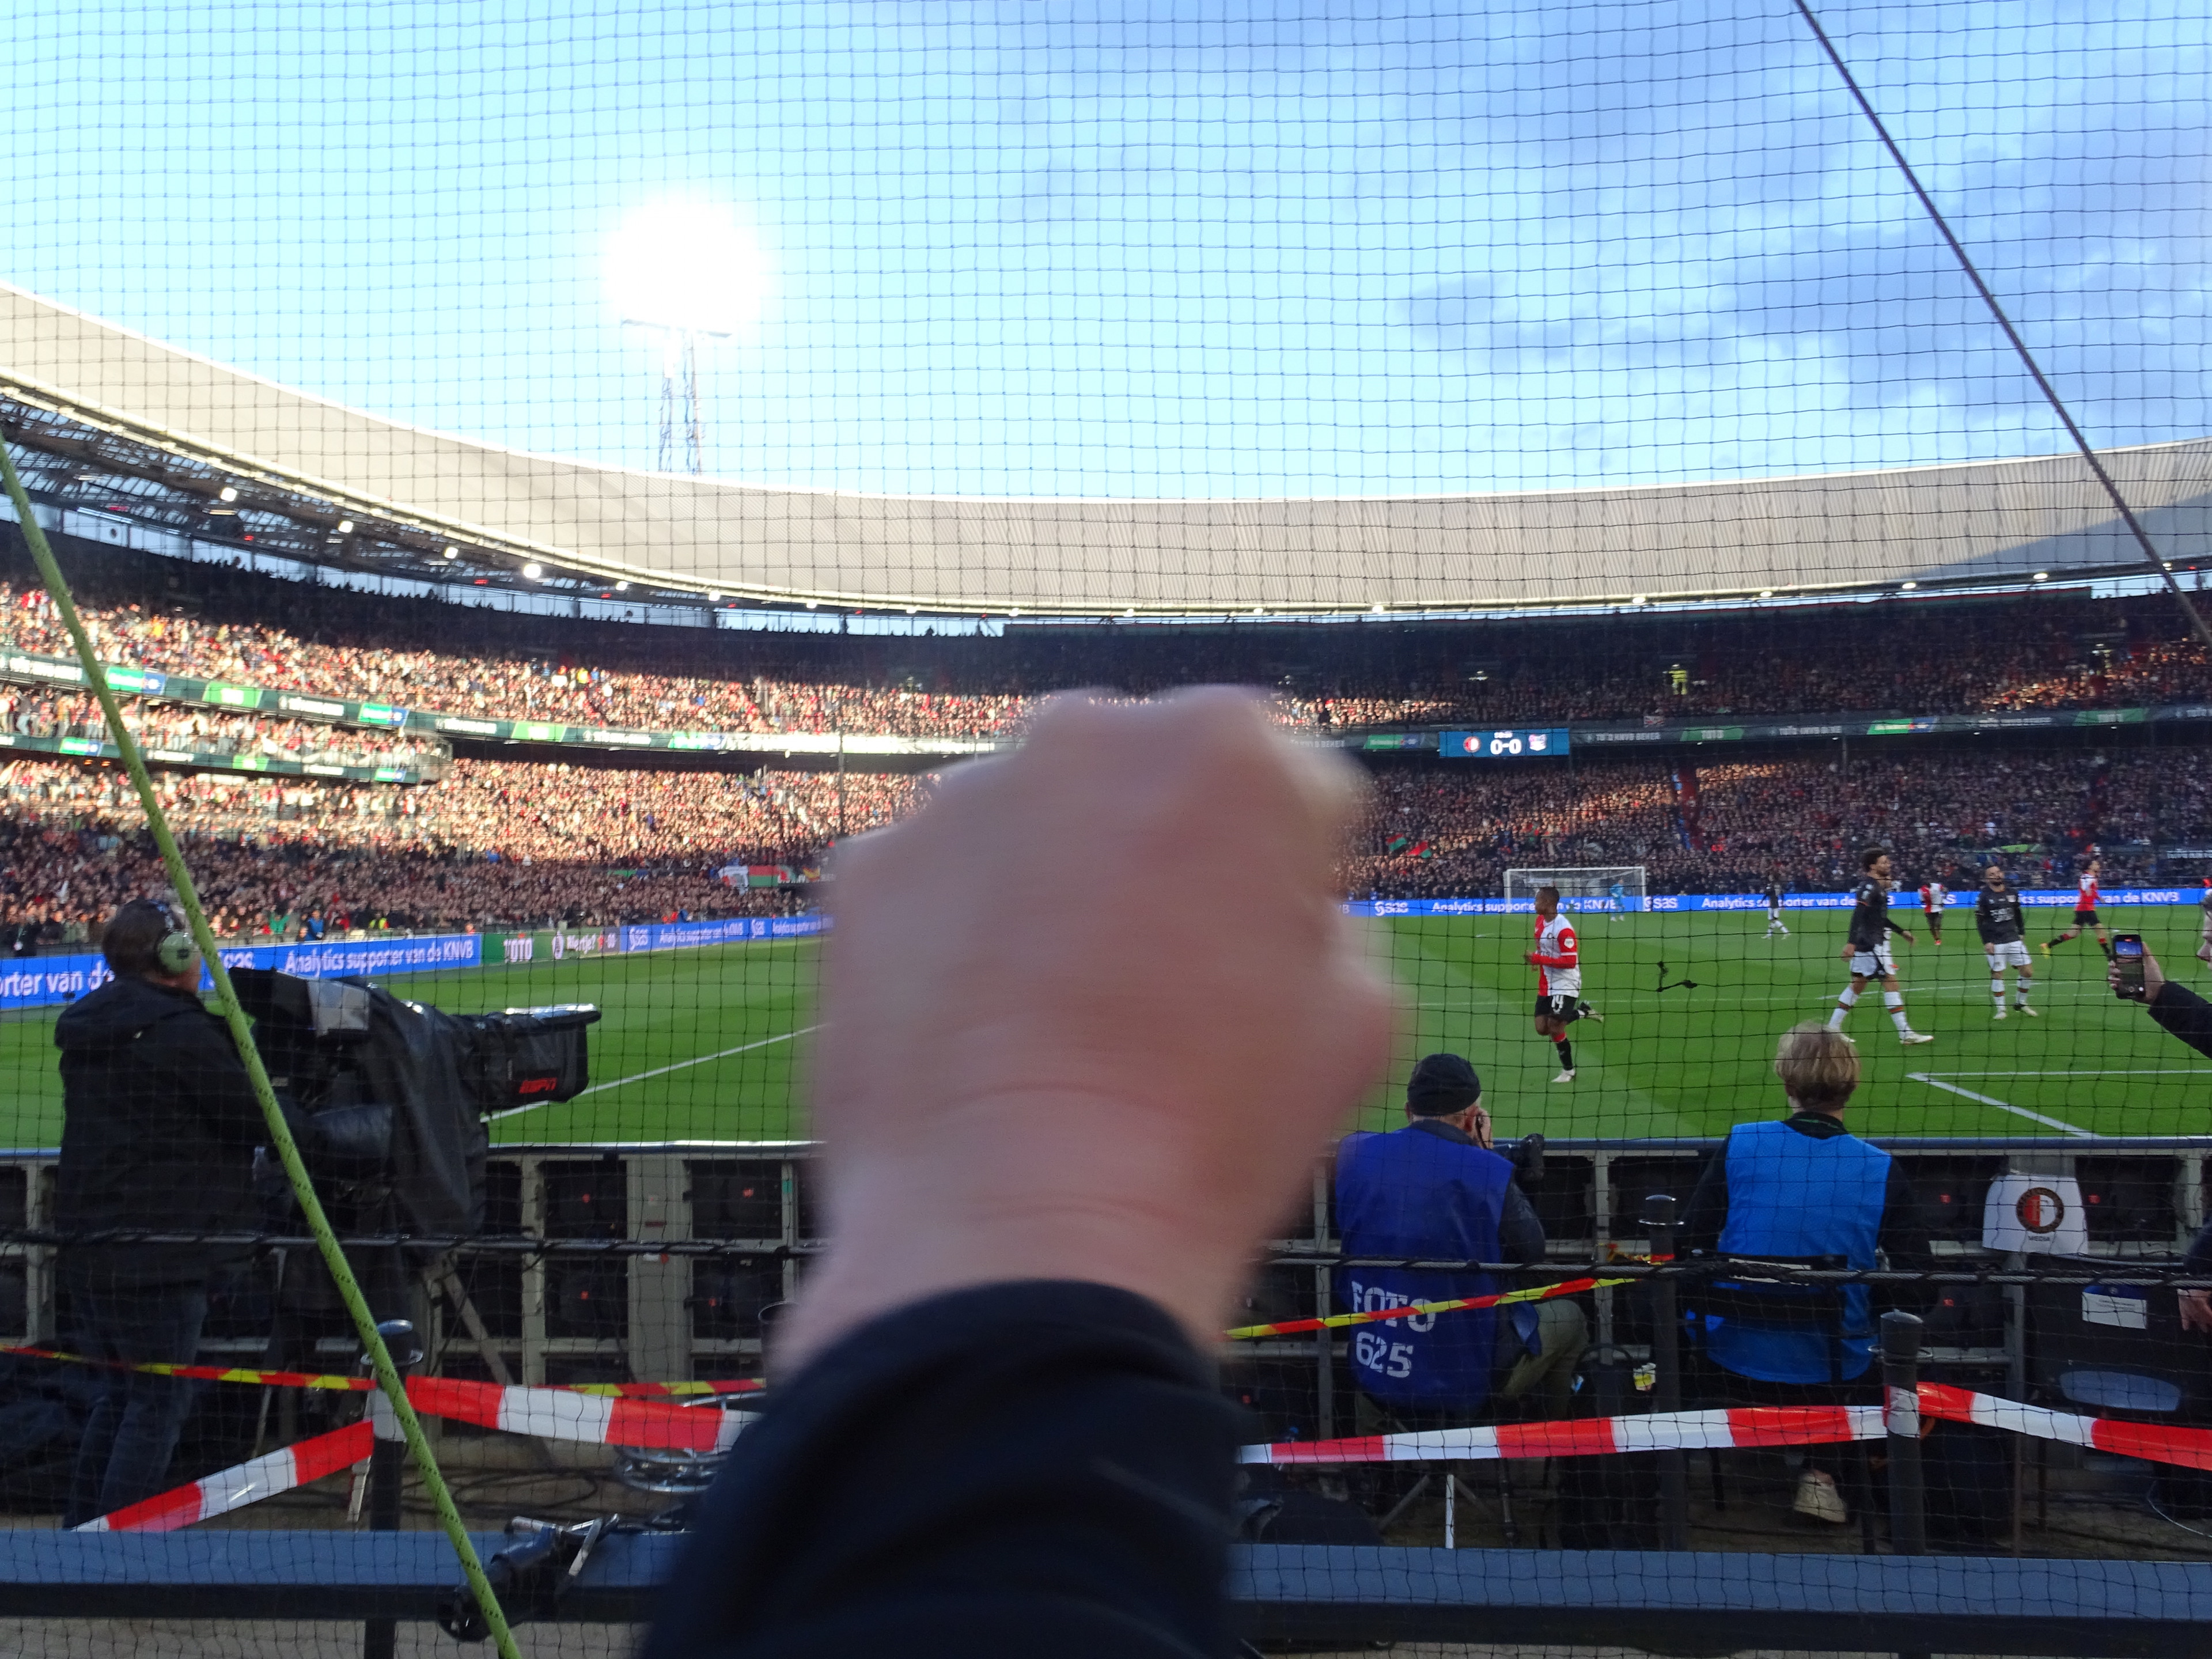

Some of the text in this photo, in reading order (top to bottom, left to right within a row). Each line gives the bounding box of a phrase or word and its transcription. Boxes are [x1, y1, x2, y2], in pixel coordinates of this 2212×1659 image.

[1490, 738, 1521, 755] 0-0
[1702, 897, 1755, 910] Analytics
[1816, 898, 1838, 907] van
[1840, 895, 1856, 906] de
[2122, 892, 2140, 903] de
[2141, 892, 2180, 903] KNVB
[1431, 902, 1483, 915] Analytics
[1484, 902, 1535, 914] supporte
[284, 940, 474, 978] Analytics supporter van de KNVB
[46, 970, 83, 994] van
[1551, 995, 1564, 1009] 14
[1351, 1281, 1436, 1332] FOTO
[1356, 1331, 1414, 1378] 625
